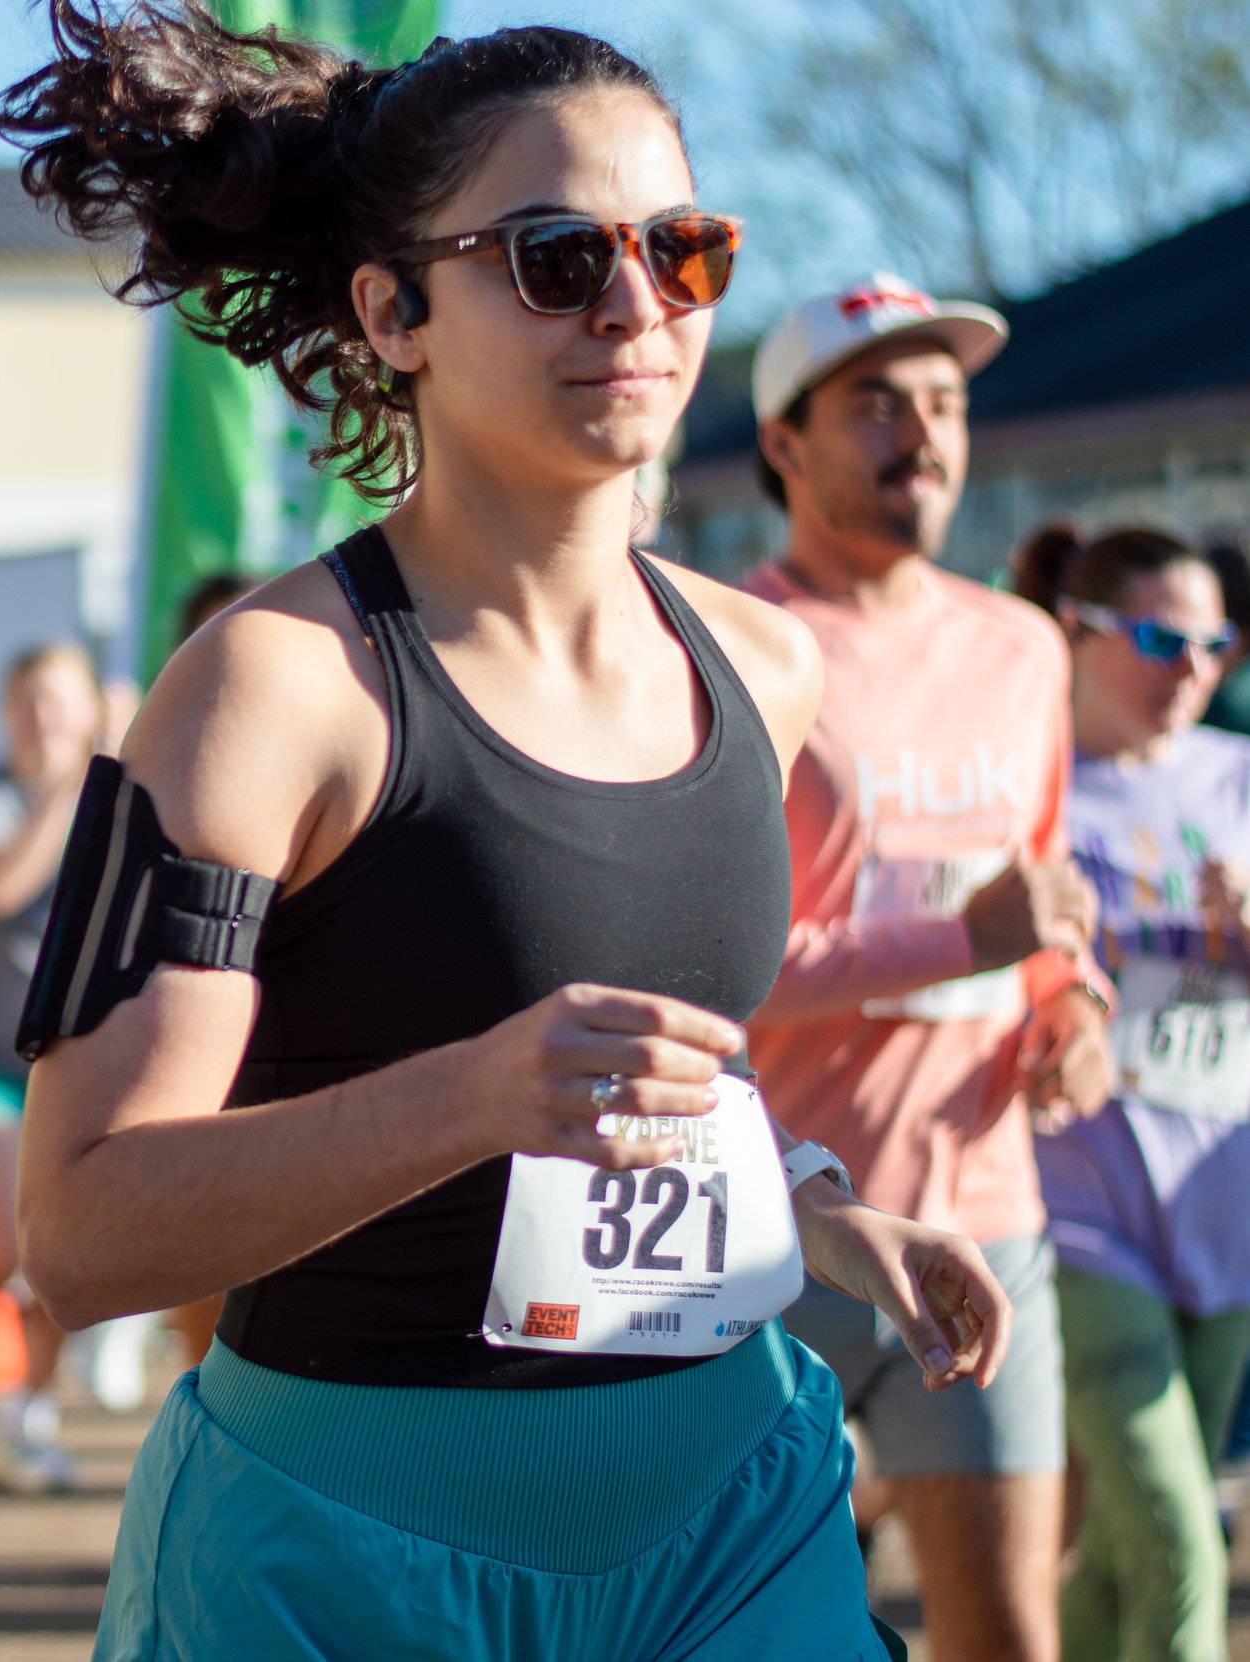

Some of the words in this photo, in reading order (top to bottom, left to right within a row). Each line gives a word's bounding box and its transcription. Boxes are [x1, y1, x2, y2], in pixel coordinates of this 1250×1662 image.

[582, 1166, 728, 1273] 321
[598, 1288, 716, 1299] www.facebook.com/racekrewe
[528, 1307, 577, 1322] EVENT
[526, 1321, 566, 1336] TECH
[724, 1320, 766, 1337] ATHLIN
